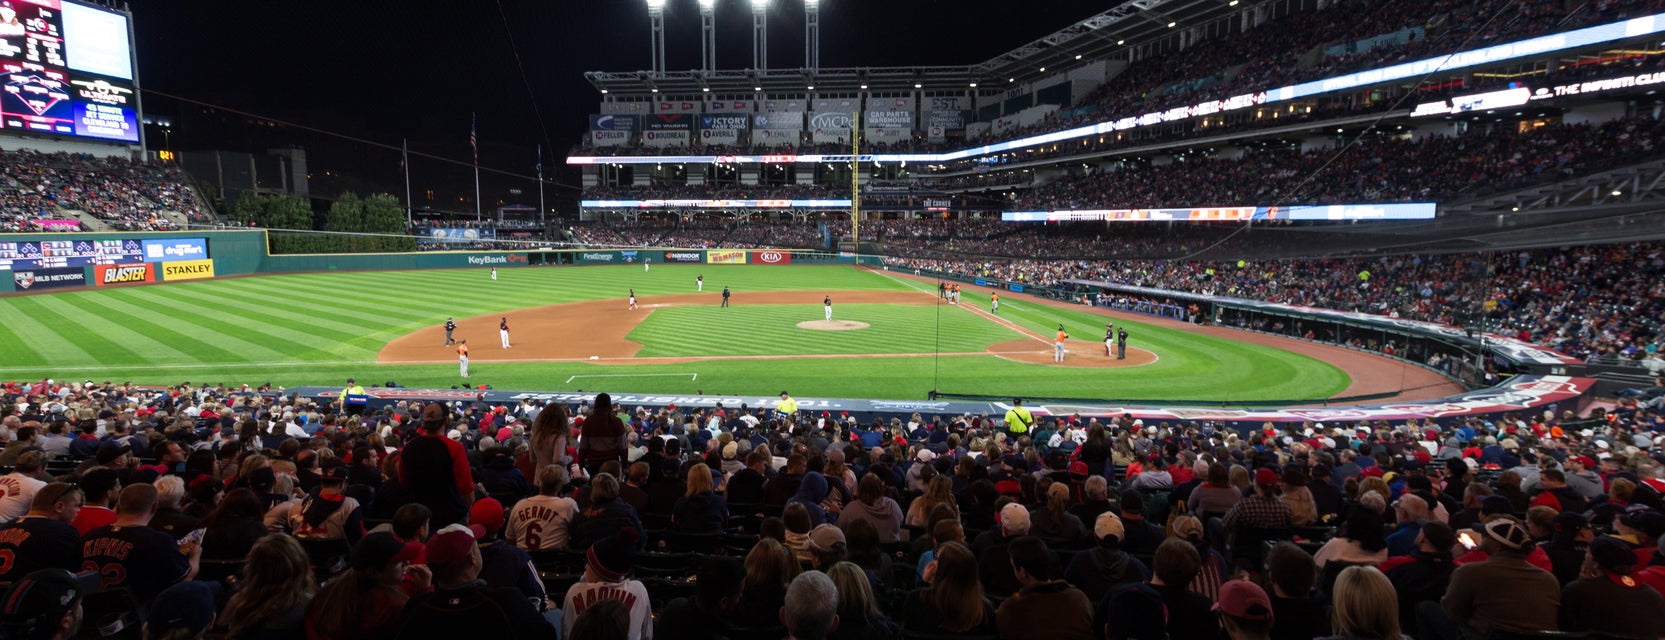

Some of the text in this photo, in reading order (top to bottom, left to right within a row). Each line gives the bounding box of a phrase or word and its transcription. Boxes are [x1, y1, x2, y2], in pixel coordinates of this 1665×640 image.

[1554, 84, 1580, 96] THE
[1581, 76, 1635, 92] INFINITI
[1635, 71, 1665, 86] CLU
[80, 90, 127, 103] ULTIMATE
[932, 98, 960, 110] EST.
[468, 255, 507, 264] KeyBank
[104, 266, 146, 284] BLASTER
[166, 264, 210, 275] STANLEY
[35, 273, 84, 283] MLB NETWORK
[525, 522, 543, 550] 6
[82, 537, 134, 561] KIPNIS
